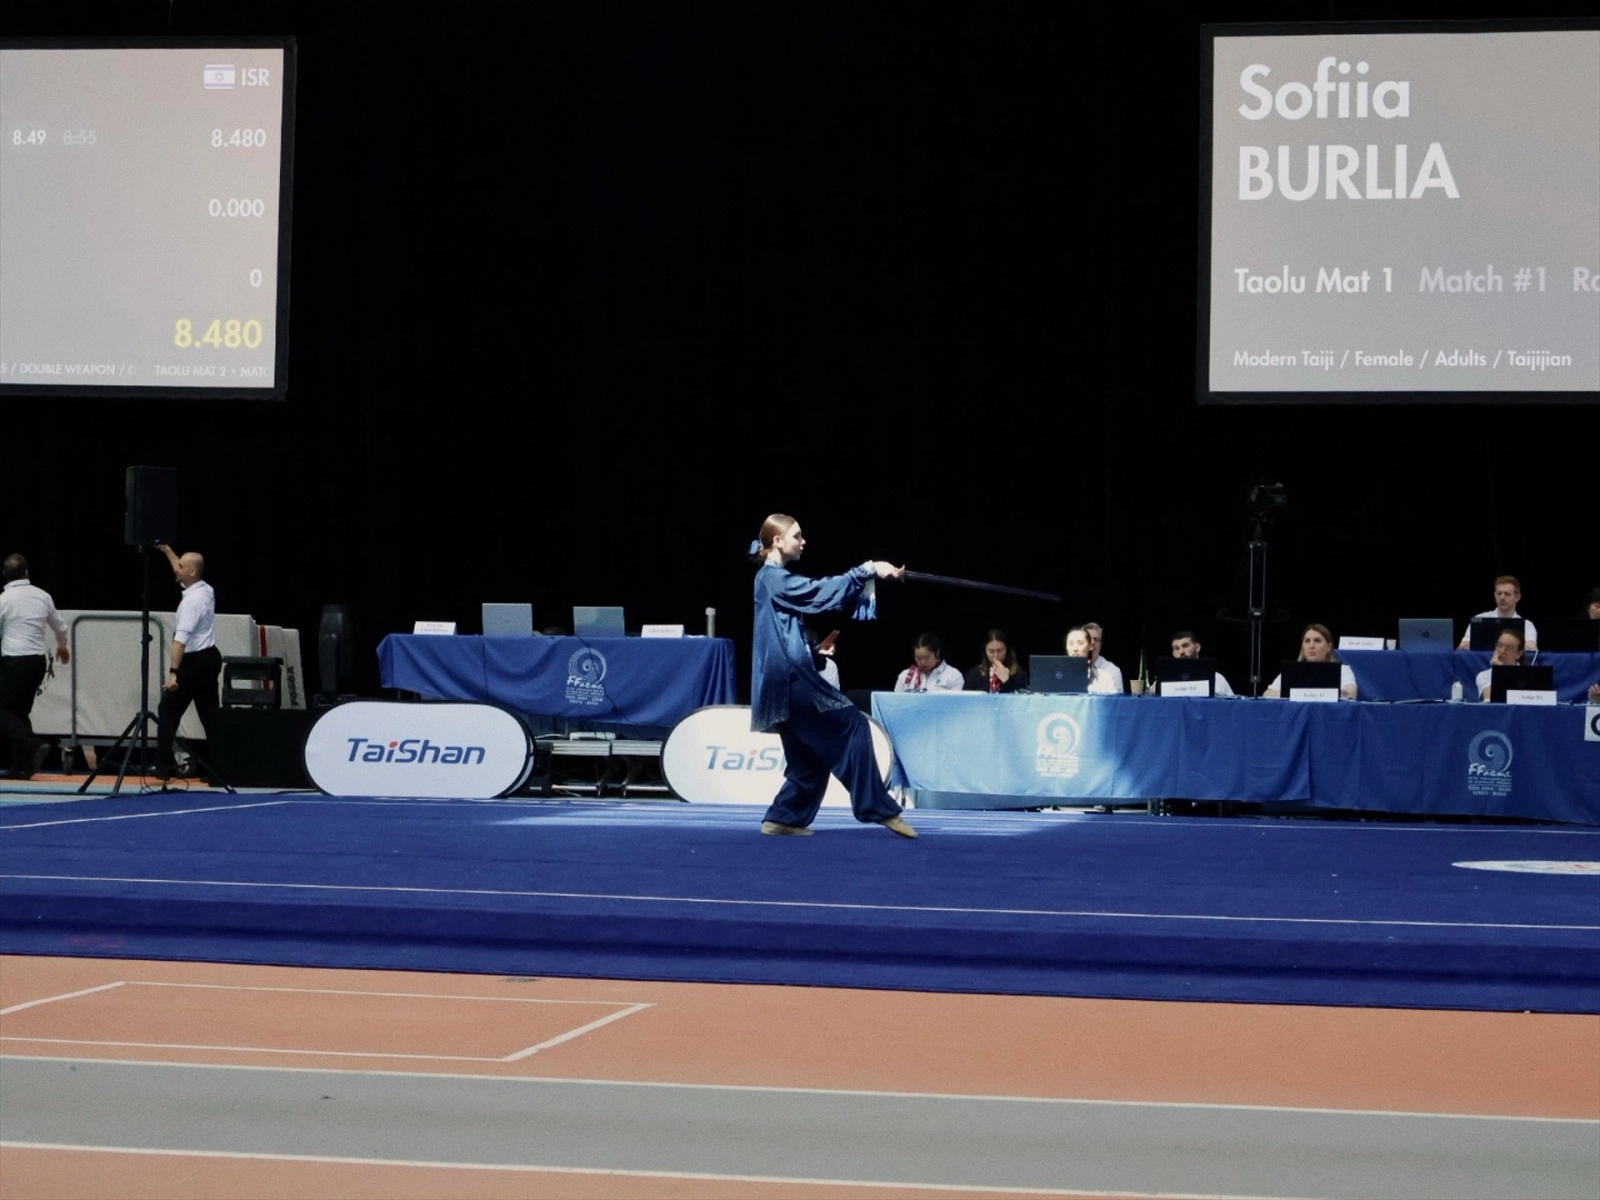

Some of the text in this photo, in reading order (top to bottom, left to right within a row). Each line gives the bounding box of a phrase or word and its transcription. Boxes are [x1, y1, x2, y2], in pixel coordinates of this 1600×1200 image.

[241, 68, 270, 87] ISR
[1238, 56, 1410, 120] Sofiia
[12, 129, 47, 145] 8.49
[211, 128, 266, 148] 8.480
[1238, 142, 1460, 201] BURLIA
[209, 199, 264, 217] 0.000
[250, 269, 262, 288] 0
[1234, 265, 1393, 294] Taolu Mat 1
[1418, 264, 1546, 293] Match #1
[174, 319, 263, 349] 8.480
[20, 363, 62, 375] DOUBLE
[64, 364, 116, 376] WEAPON
[155, 365, 190, 377] TAOLU
[192, 366, 217, 377] MAT
[219, 366, 227, 377] 2
[1233, 349, 1297, 366] Modern
[1301, 350, 1334, 371] Taiji
[1355, 349, 1414, 366] Female
[1434, 349, 1487, 366] Adults
[1507, 350, 1572, 371] Taijijian
[347, 738, 486, 764] TaiShan
[706, 745, 787, 770] TaiS
